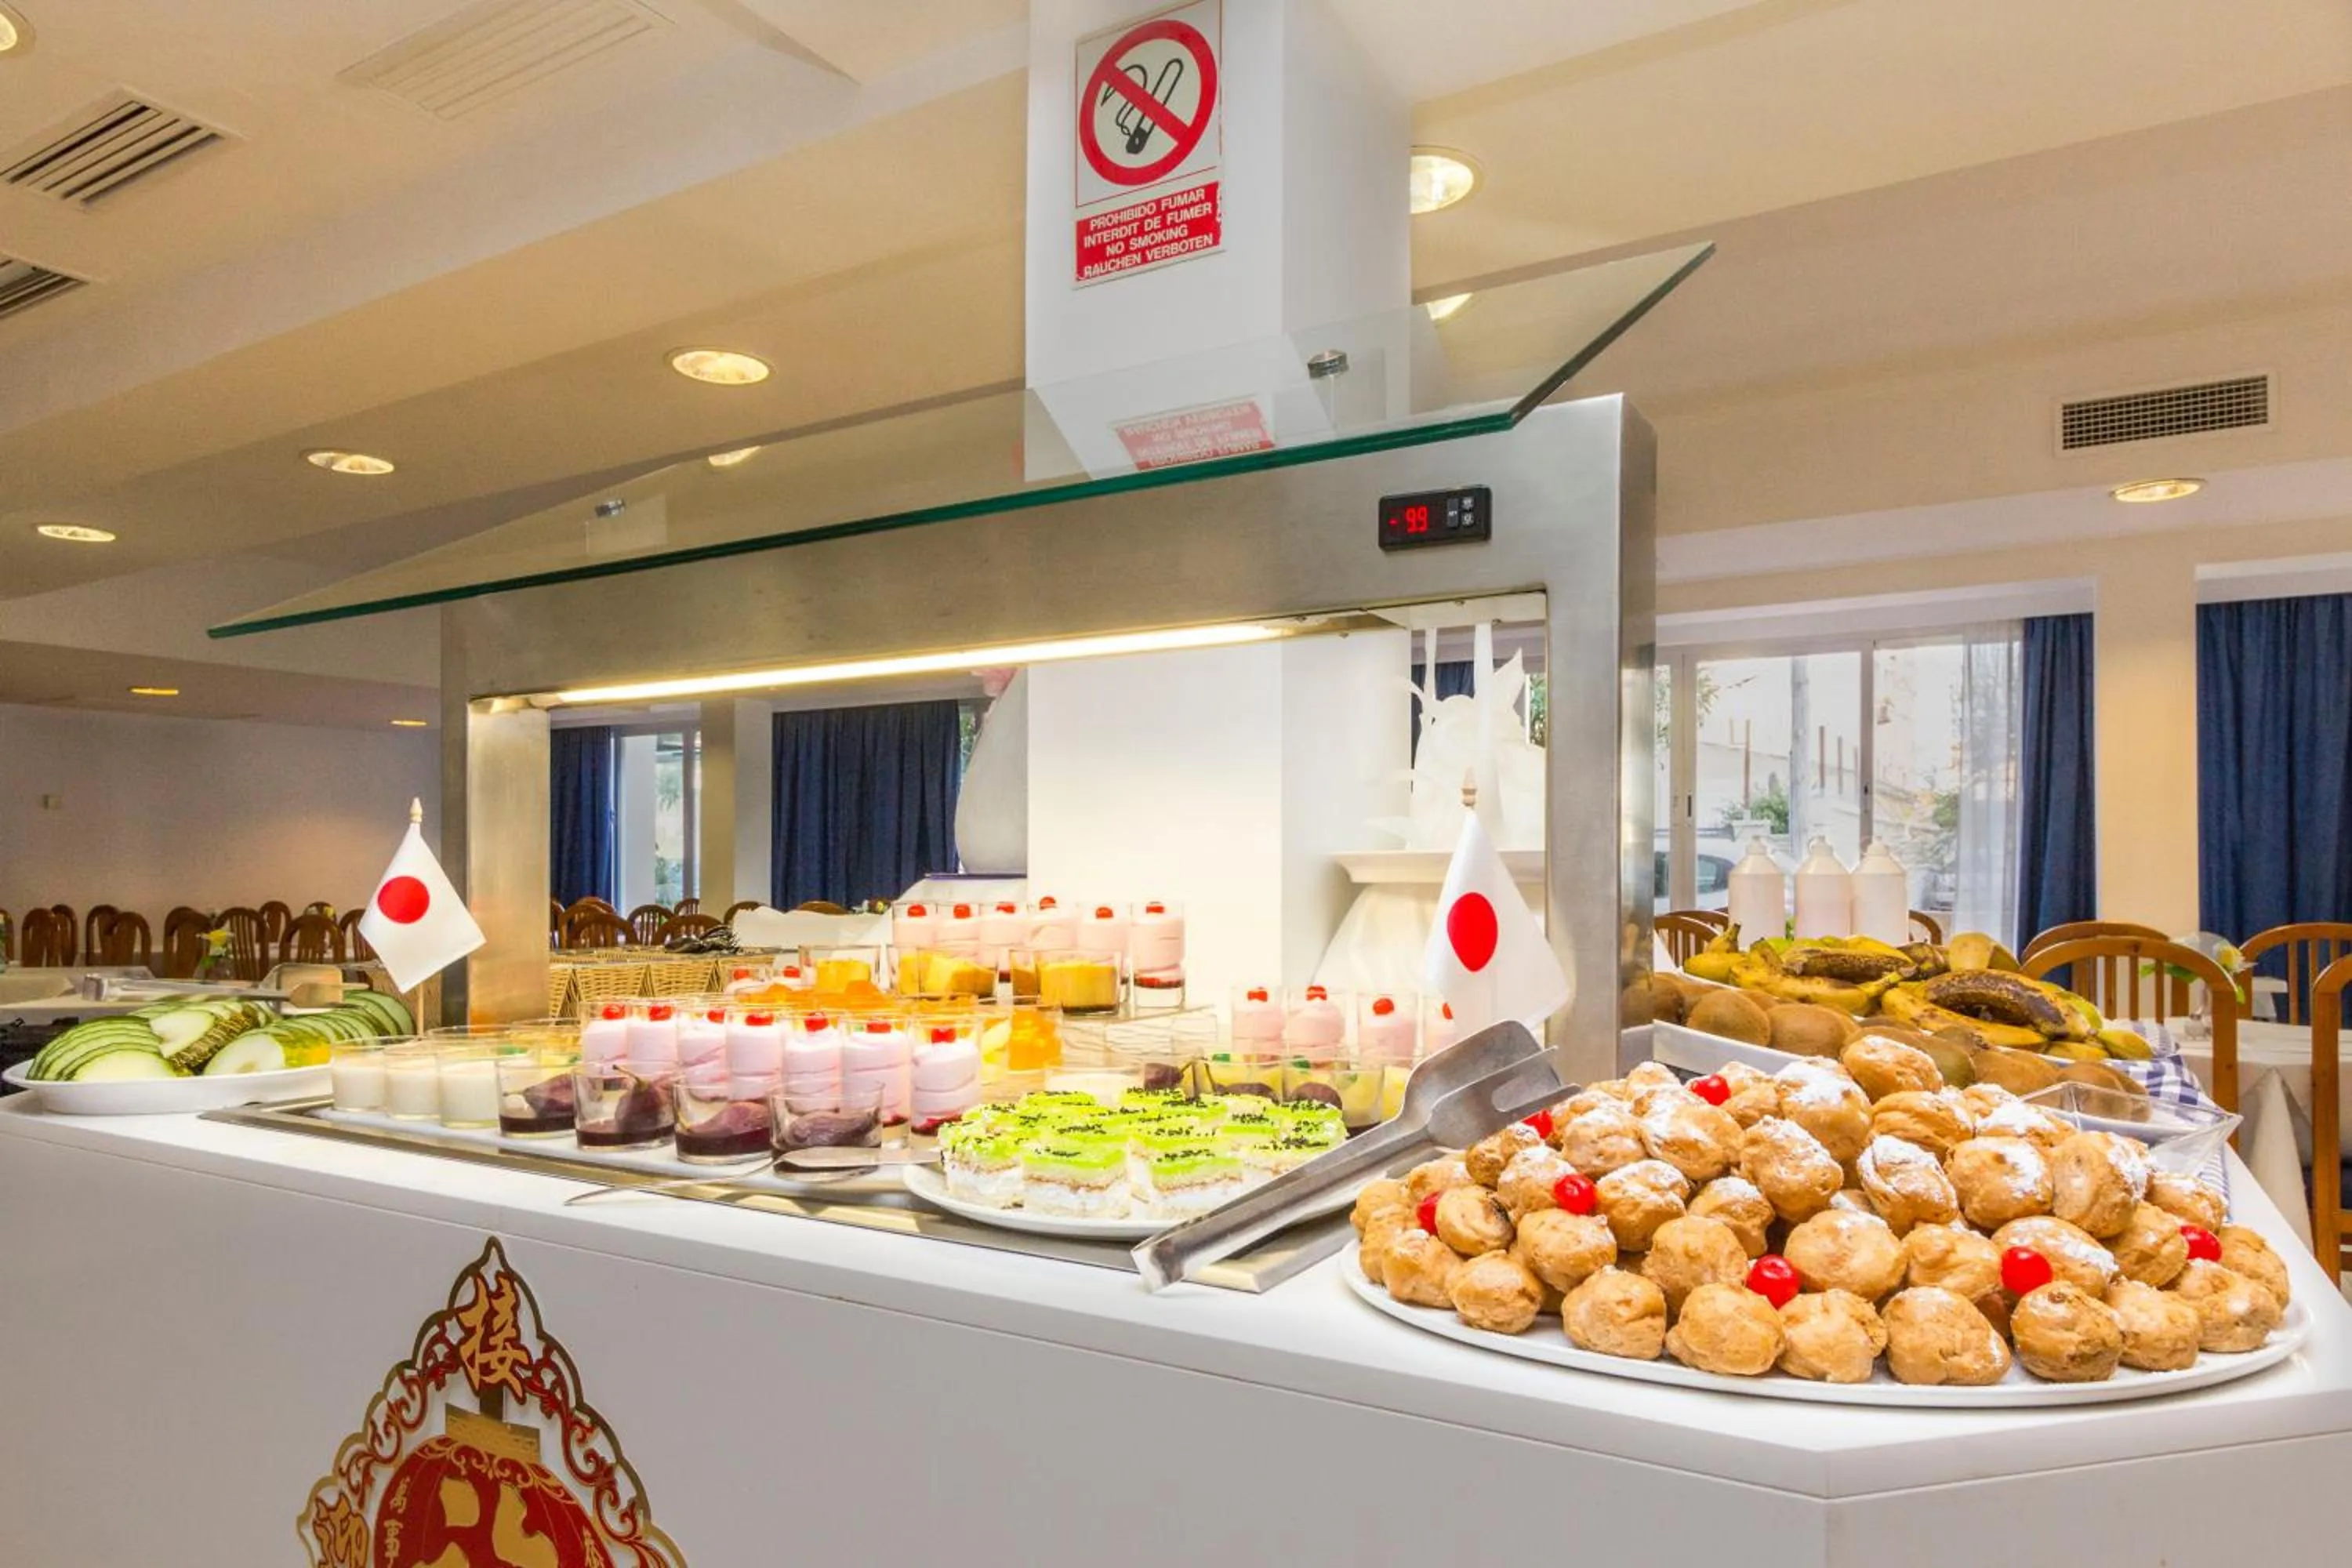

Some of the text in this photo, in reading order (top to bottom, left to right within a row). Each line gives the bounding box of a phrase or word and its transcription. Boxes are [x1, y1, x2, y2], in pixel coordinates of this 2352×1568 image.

[1083, 203, 1212, 249] INTERDIT DE FUMER
[1090, 188, 1206, 230] PROHIBIDO FUMAR
[1083, 231, 1213, 278] RAUCHEN VERBOTEN
[1106, 225, 1188, 257] NO SMOKING
